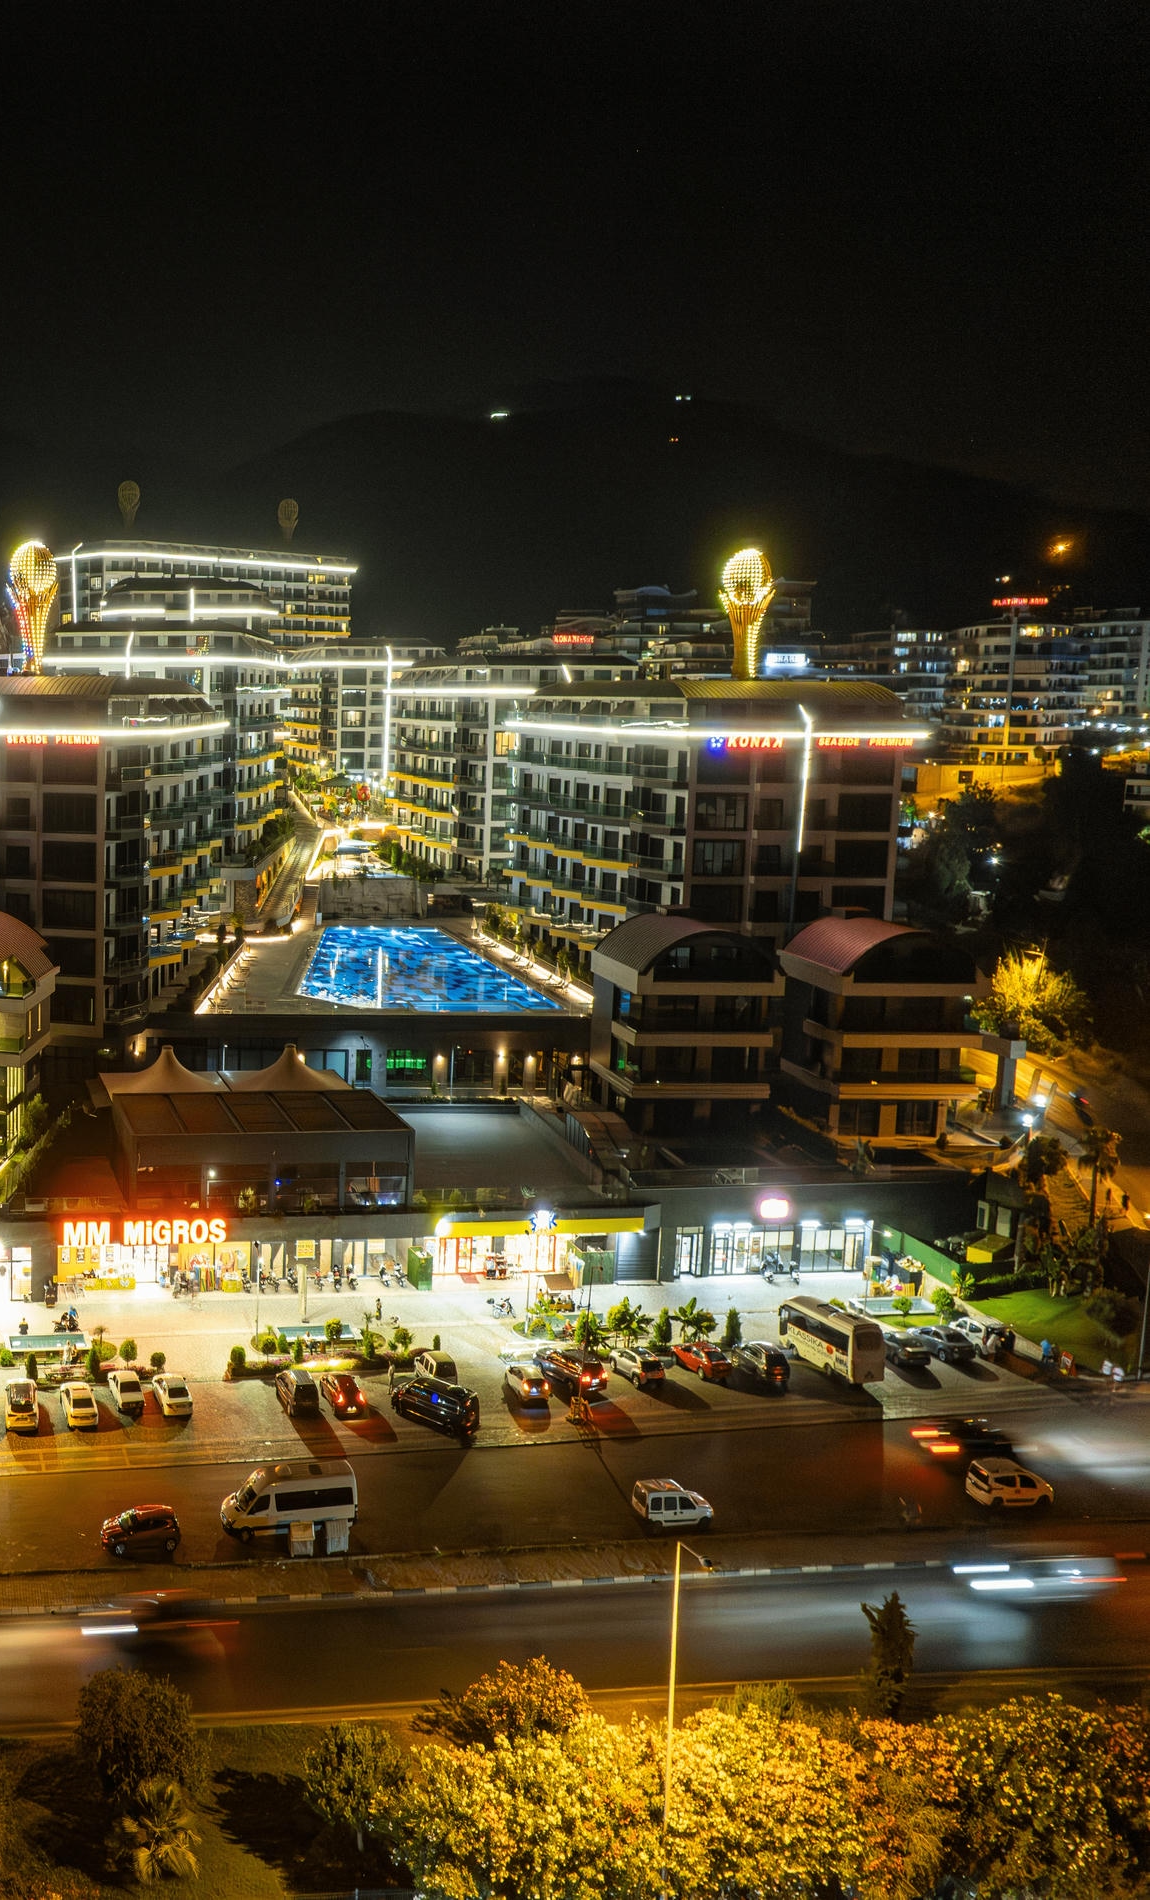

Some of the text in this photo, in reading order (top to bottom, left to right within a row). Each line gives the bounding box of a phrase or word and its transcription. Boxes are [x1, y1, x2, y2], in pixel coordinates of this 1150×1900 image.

[6, 735, 48, 744] SEASIDE
[55, 735, 99, 745] PREMIUM
[818, 737, 860, 746] SEASIDE
[869, 737, 913, 747] PREMIUM
[63, 1221, 111, 1246] MM
[788, 1326, 824, 1349] KLASSIKA
